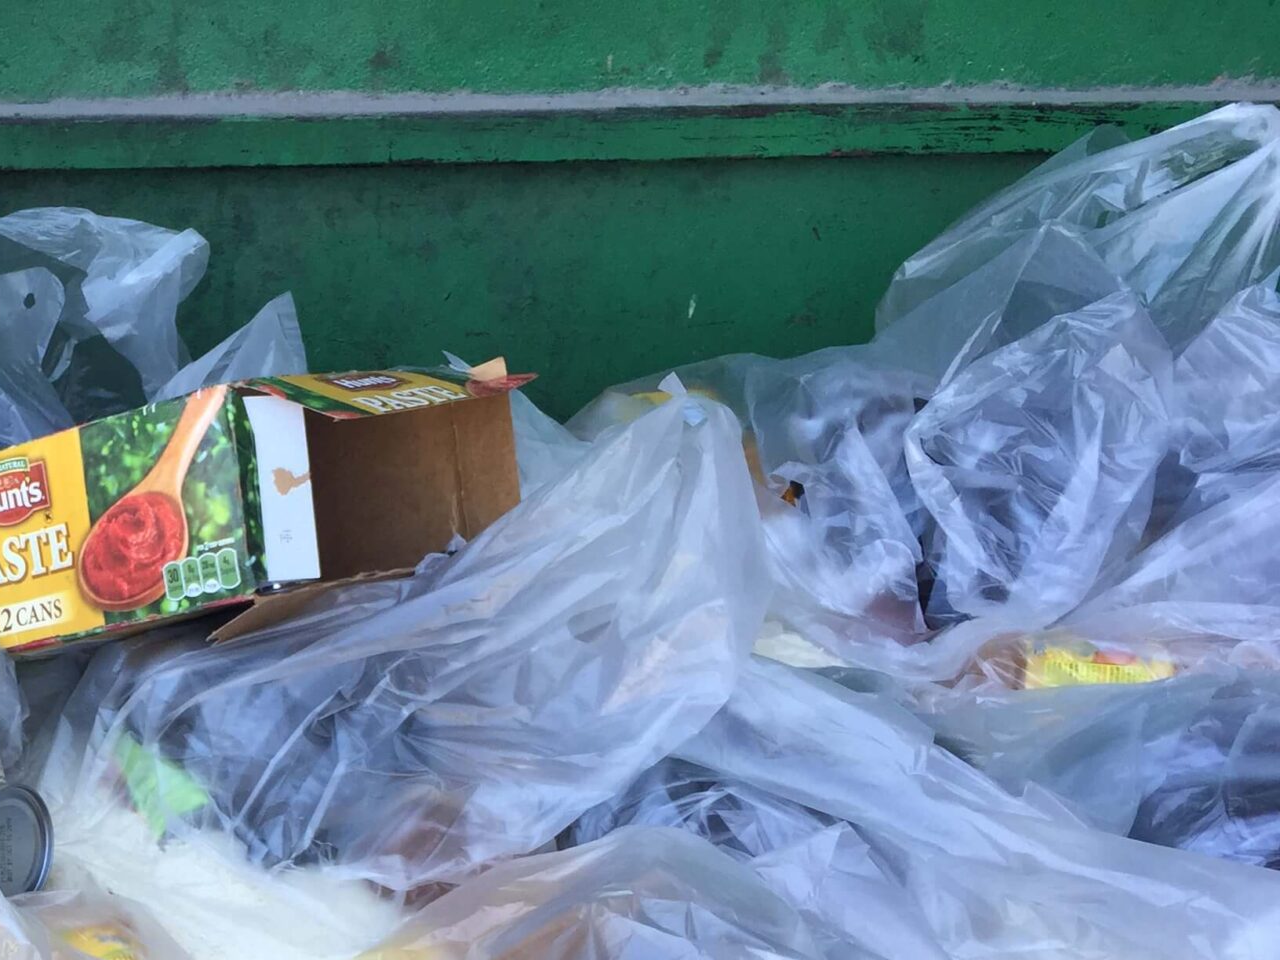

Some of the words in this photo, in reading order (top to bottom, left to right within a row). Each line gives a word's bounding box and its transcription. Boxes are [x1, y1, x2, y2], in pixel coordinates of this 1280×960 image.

[332, 375, 397, 389] Hunt's
[352, 385, 468, 413] PASTE
[167, 567, 179, 584] 30
[16, 598, 63, 627] CANS
